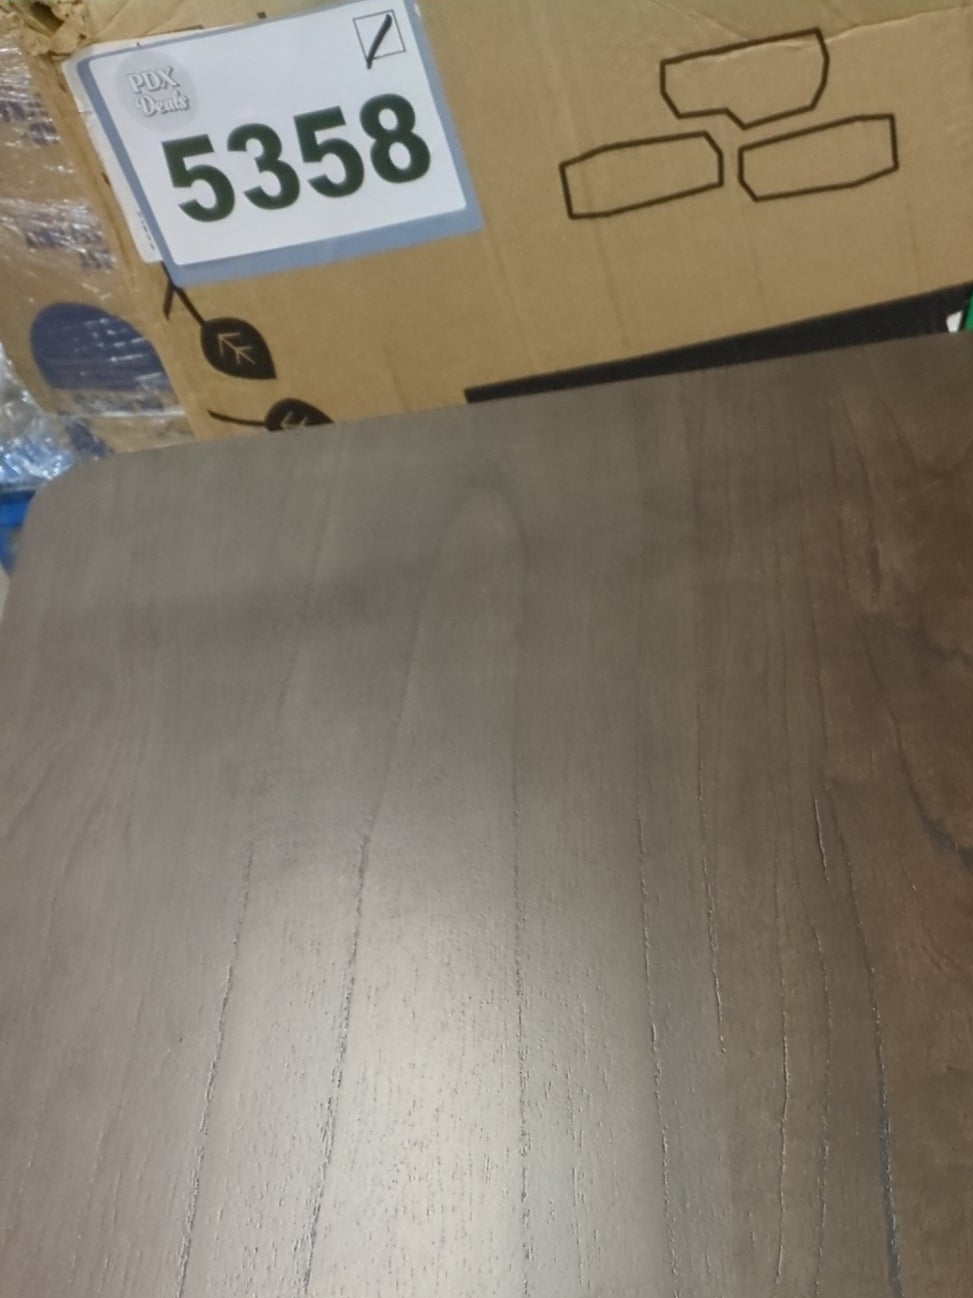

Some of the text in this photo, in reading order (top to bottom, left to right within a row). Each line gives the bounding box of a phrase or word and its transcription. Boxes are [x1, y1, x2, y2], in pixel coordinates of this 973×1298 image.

[127, 66, 179, 94] PDX
[135, 90, 190, 117] Deals
[162, 93, 431, 223] 5358
